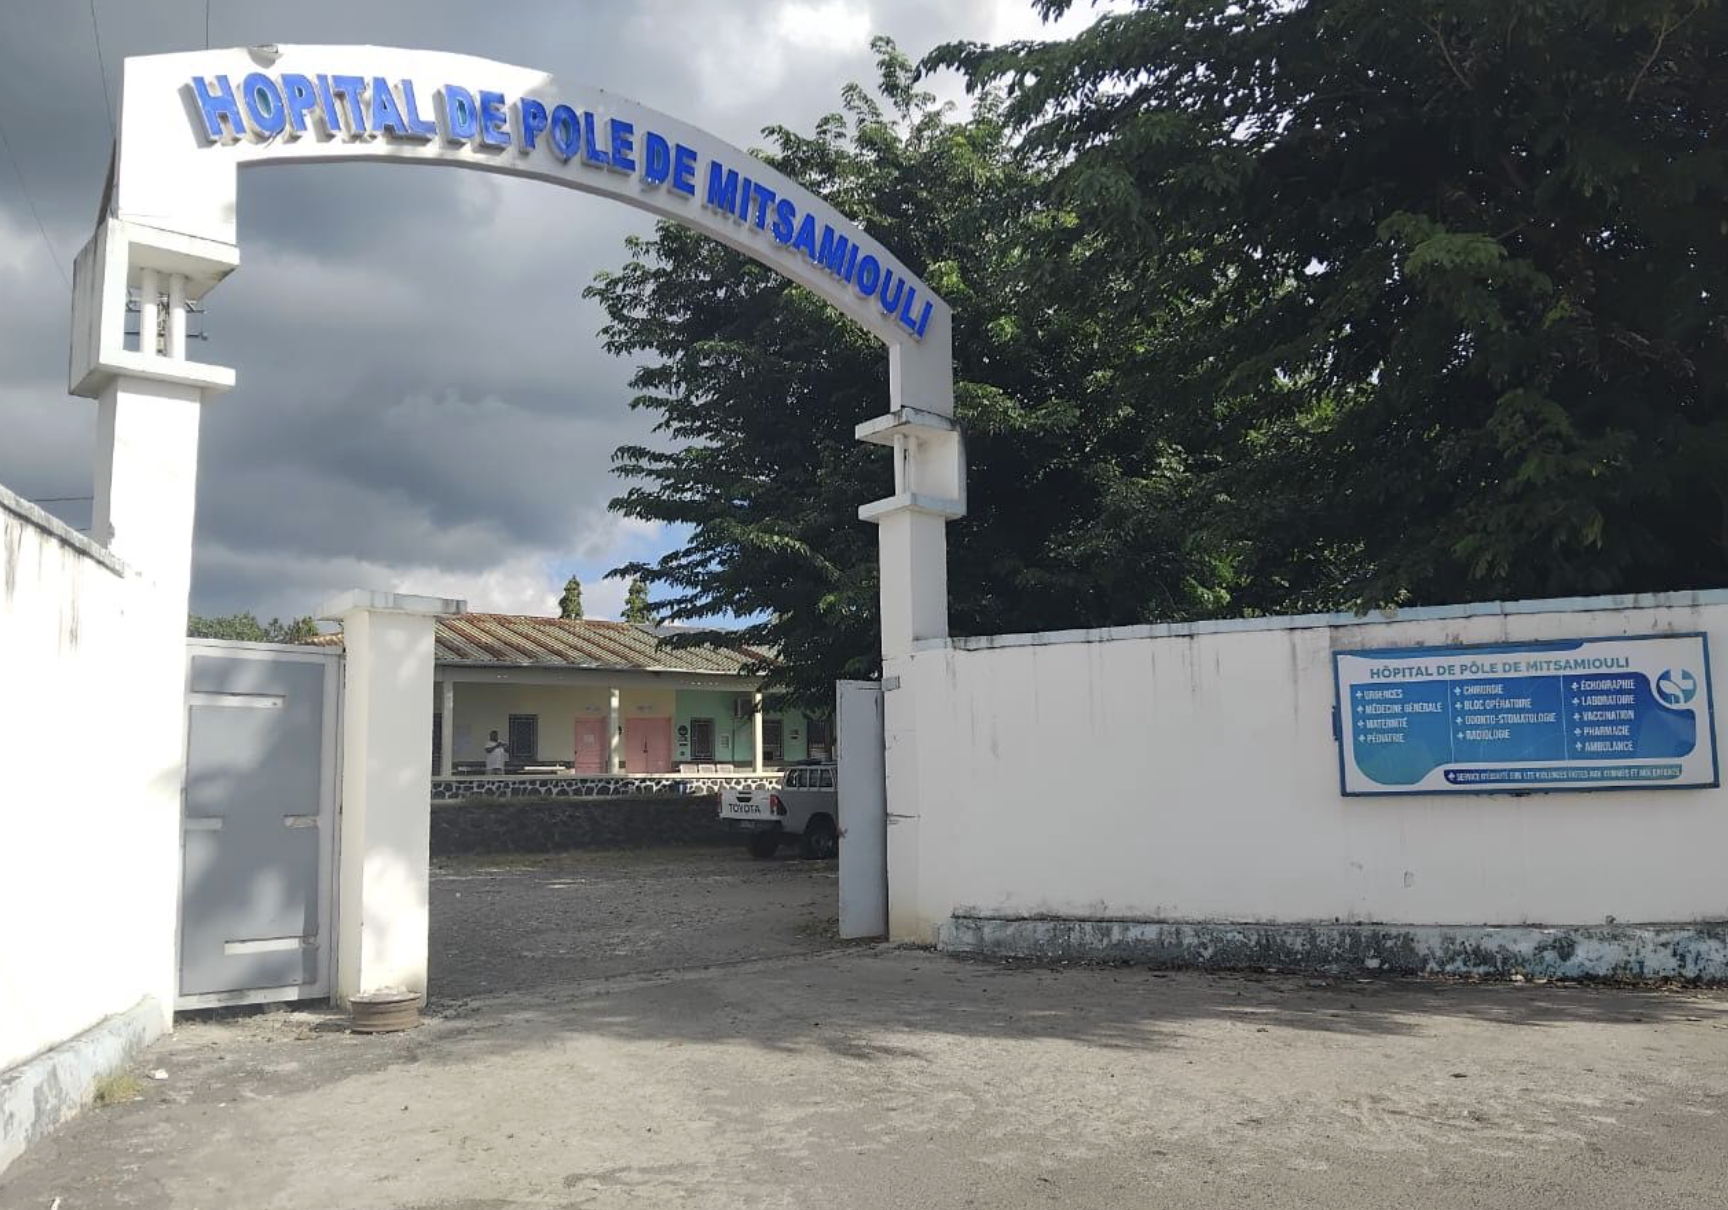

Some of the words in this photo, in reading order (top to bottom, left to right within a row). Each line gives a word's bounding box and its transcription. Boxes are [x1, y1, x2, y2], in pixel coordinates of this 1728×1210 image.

[188, 71, 438, 138] HOPITAL
[442, 83, 512, 146] DE
[518, 95, 637, 173] POLE
[644, 129, 698, 197] DE
[706, 160, 934, 339] MITSAMIOULI
[1370, 665, 1433, 679] HÔPITAL
[1437, 665, 1456, 676] DE
[1460, 661, 1498, 675] PÔLE
[1502, 661, 1522, 673] DE
[1526, 657, 1630, 672] MITSAMIOULI
[1463, 683, 1504, 695] CHIRURGIE
[1581, 679, 1636, 691] ÉCHOGRAPHIE
[1364, 689, 1403, 700] URGENCES
[1582, 694, 1636, 706] LABORATOIRE
[1365, 702, 1403, 714] MÉDECINE
[1404, 701, 1443, 713] GÉNÉRALE
[1464, 699, 1484, 710] BLOC
[1485, 697, 1532, 709] OPÉRATOIRE
[1465, 712, 1556, 725] ODONTO-STOMATOLOGIE
[1582, 709, 1635, 721] VACCINATION
[1366, 716, 1408, 728] MATERNITÉ
[1465, 729, 1511, 740] RADIOLOGIE
[1583, 725, 1630, 736] PHARMACIE
[1366, 731, 1405, 743] PÉDIATRIE
[1585, 740, 1634, 752] AMBULANCE
[729, 803, 761, 813] TOYOTA
